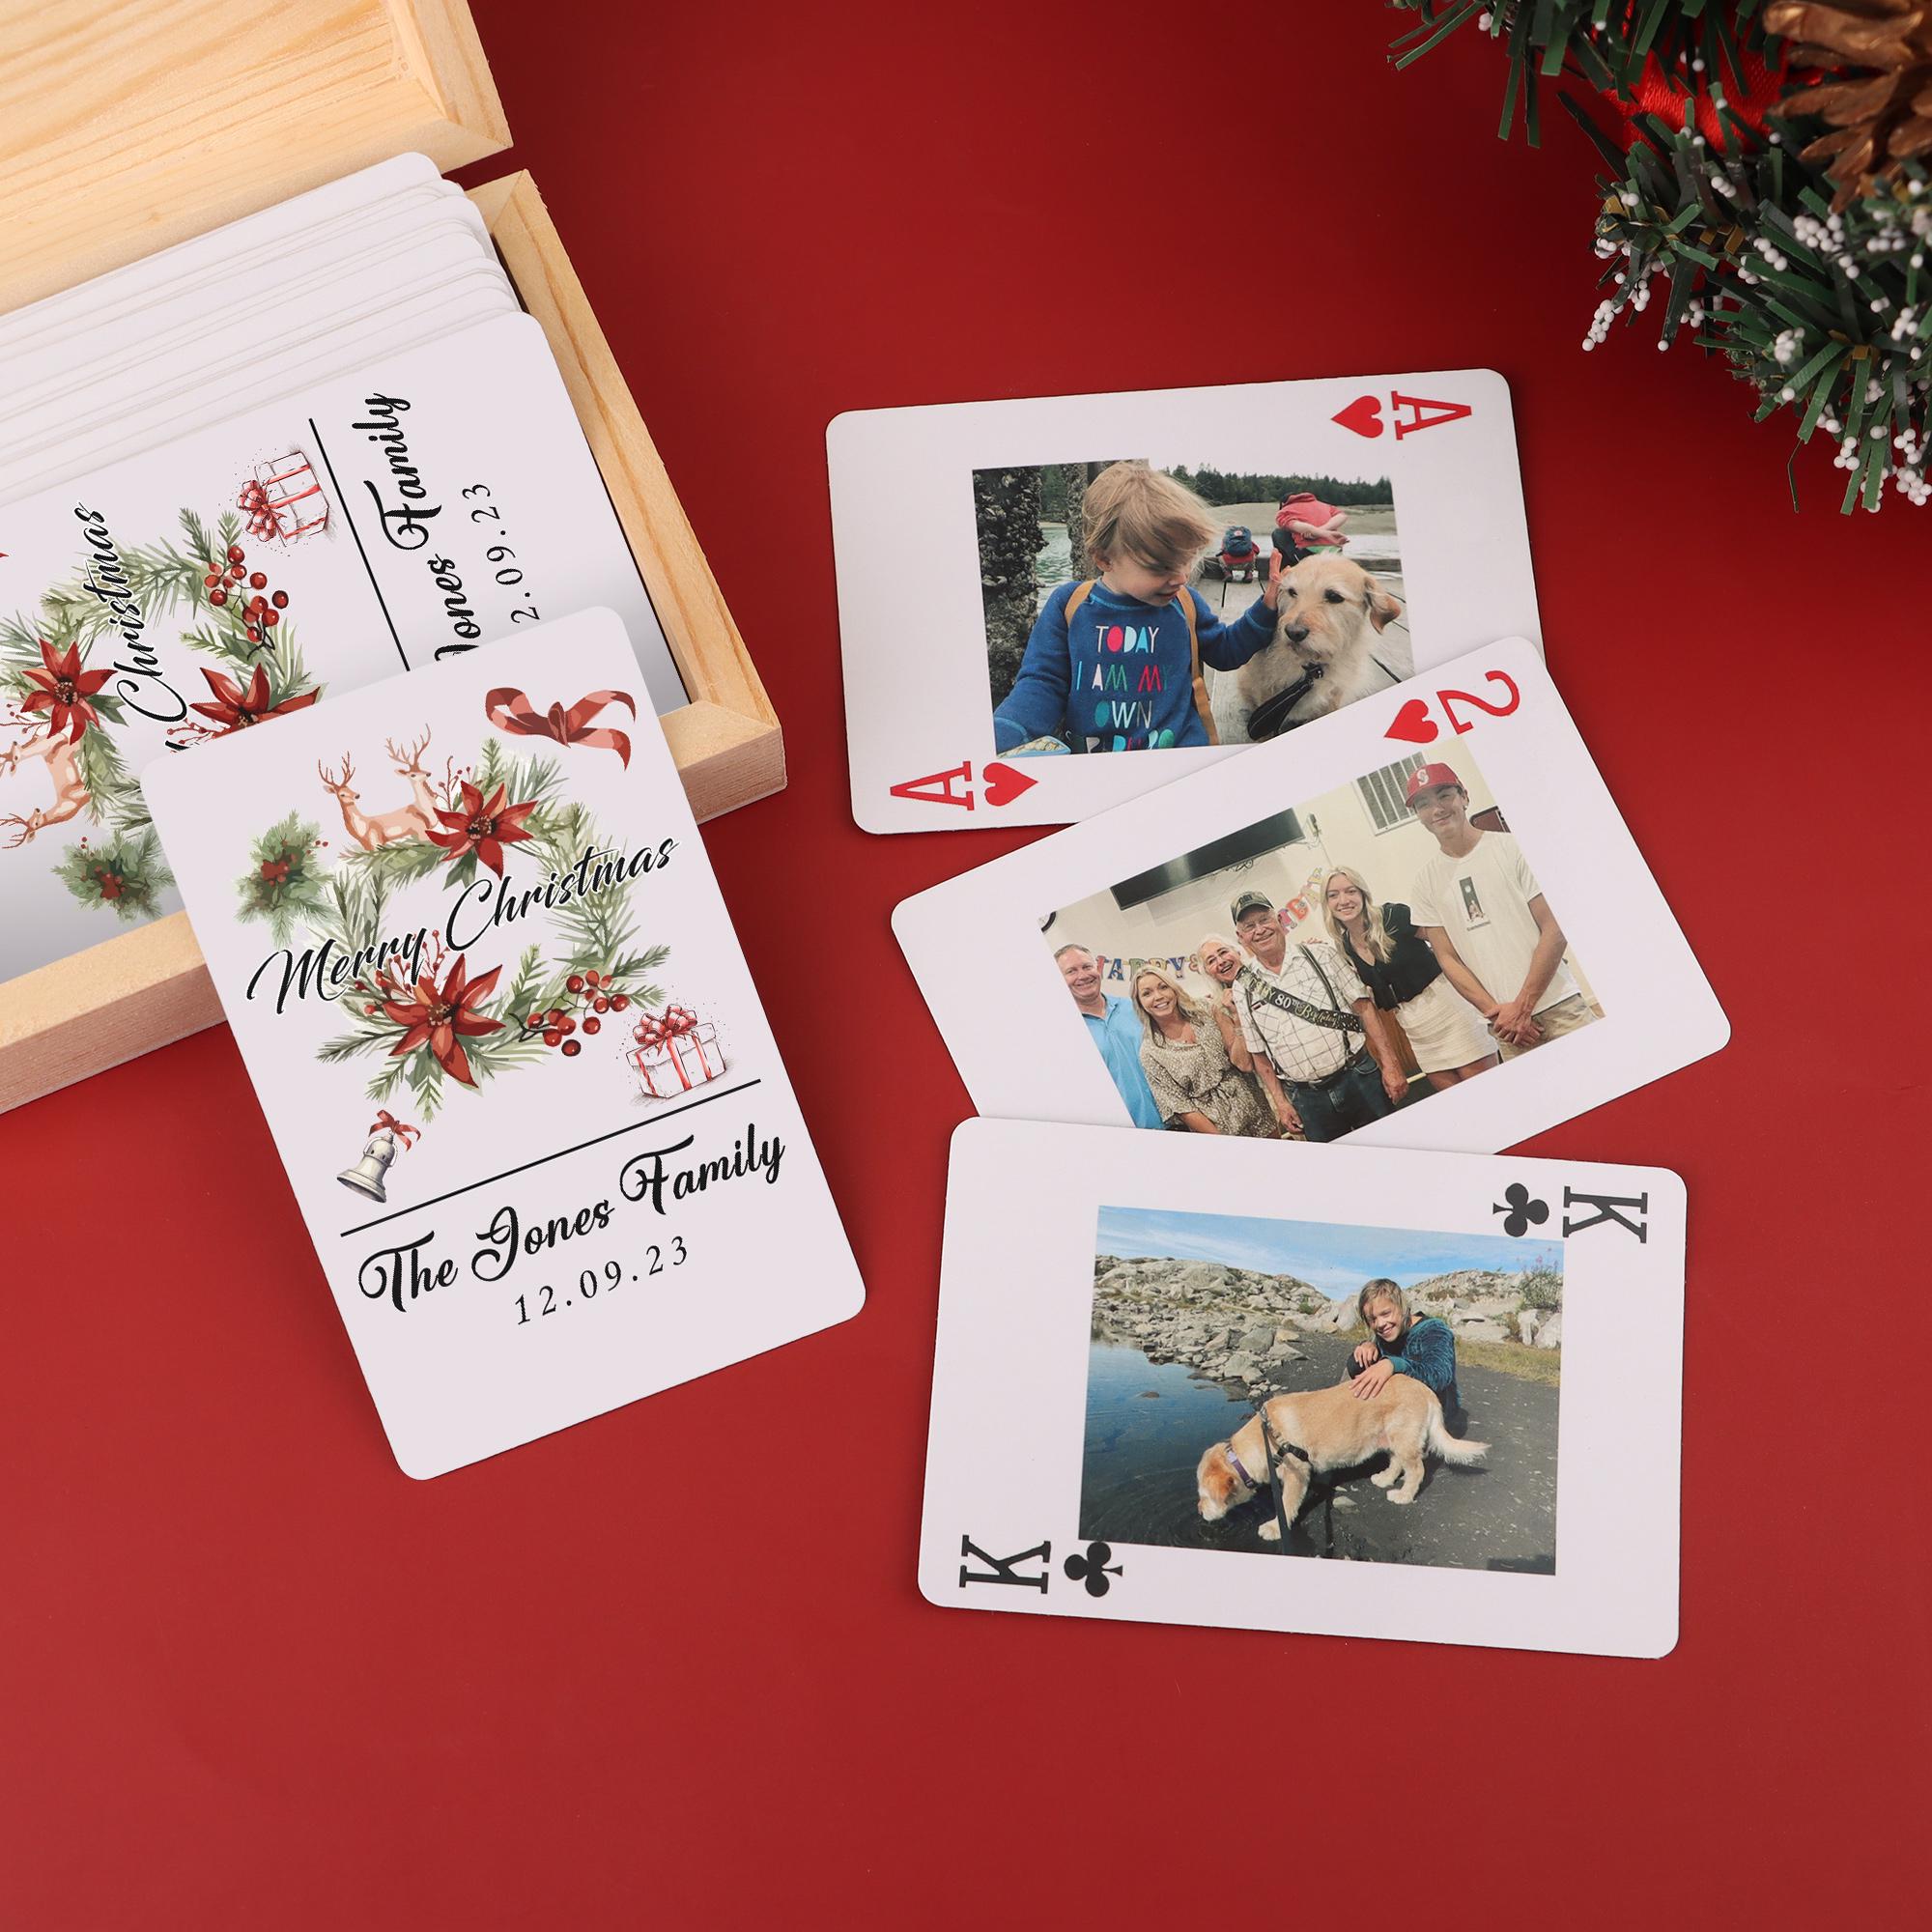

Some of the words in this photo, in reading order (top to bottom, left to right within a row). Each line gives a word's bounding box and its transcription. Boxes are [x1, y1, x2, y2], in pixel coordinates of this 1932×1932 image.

[1391, 390, 1472, 440] A
[352, 392, 442, 551] Family
[463, 484, 541, 624] 2.09.23
[74, 501, 188, 723] Christmas
[1095, 625, 1159, 654] TODAY
[1076, 661, 1082, 691] I
[1092, 663, 1128, 692] AM
[1137, 664, 1174, 693] MY
[1435, 669, 1520, 735] 2
[1094, 700, 1152, 729] OWN
[890, 760, 975, 810] A
[1416, 769, 1430, 786] S
[245, 929, 427, 1015] Merry
[445, 838, 680, 952] Christmas
[357, 1231, 459, 1313] The
[470, 1199, 615, 1282] Jones
[619, 1122, 786, 1215] Family
[1562, 1186, 1648, 1243] K
[515, 1236, 687, 1325] 12.09.23
[958, 1534, 1052, 1595] K
